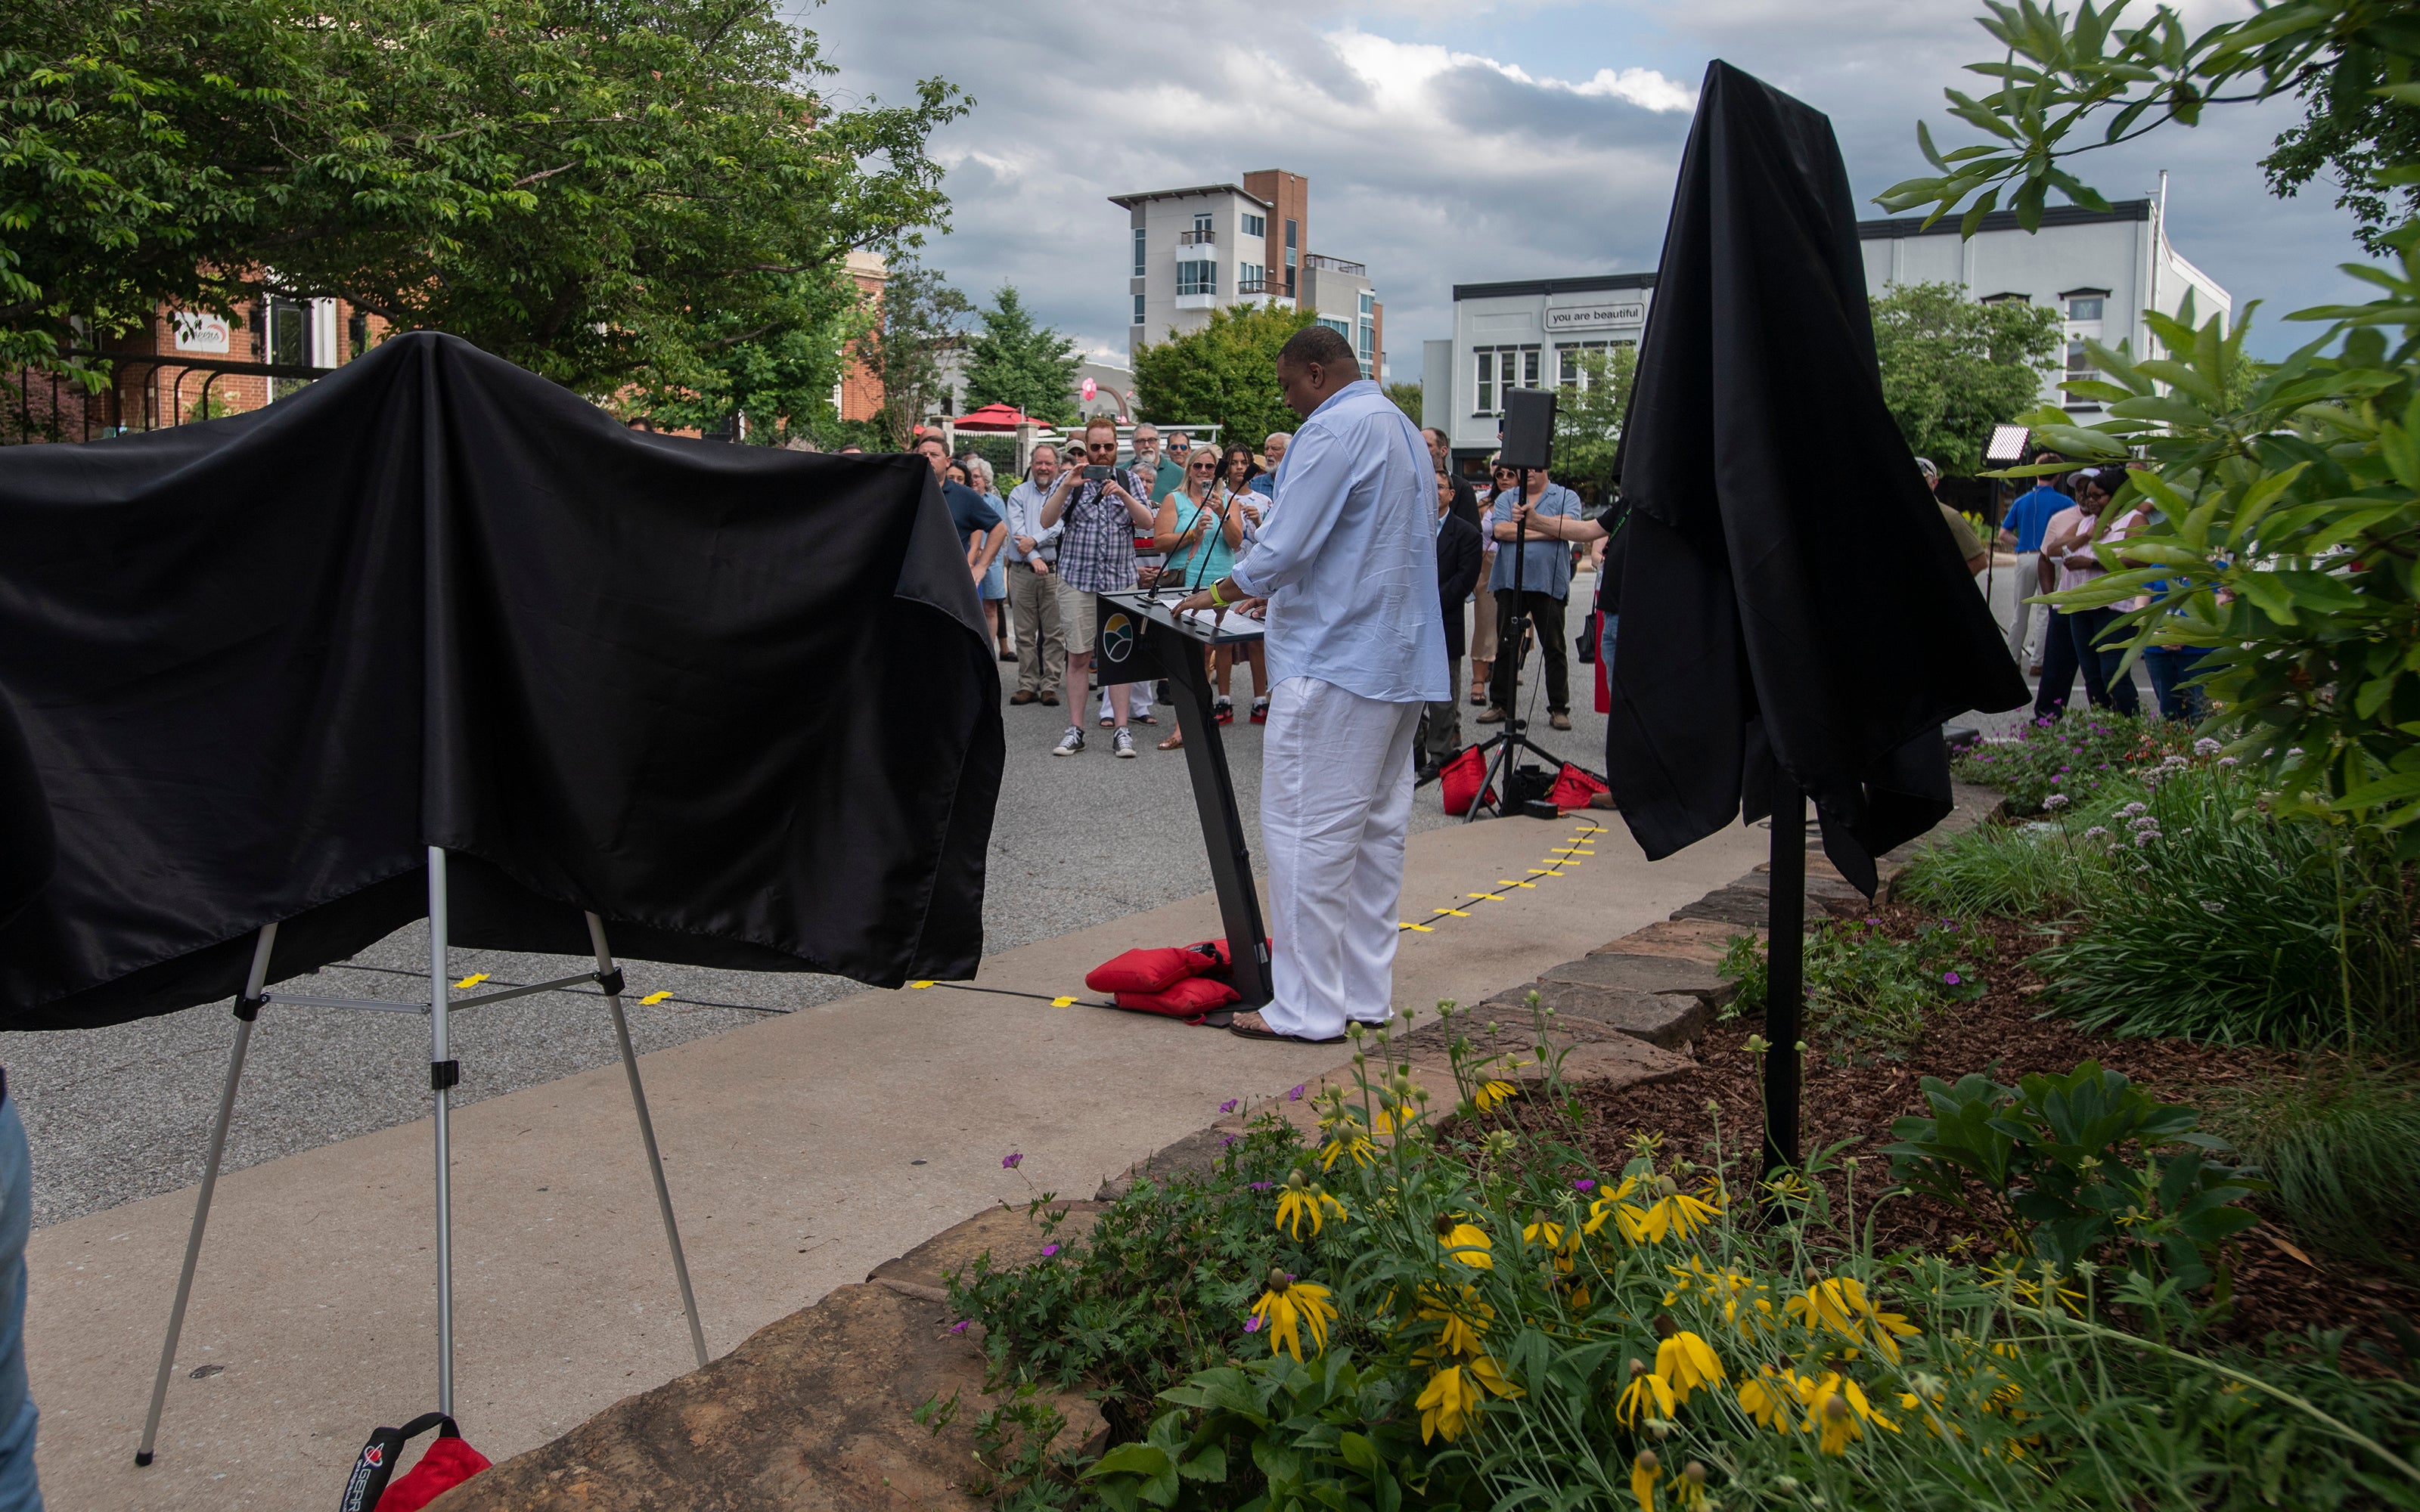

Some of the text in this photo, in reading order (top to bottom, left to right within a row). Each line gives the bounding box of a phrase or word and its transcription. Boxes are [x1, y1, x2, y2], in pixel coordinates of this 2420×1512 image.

[1553, 308, 1638, 324] you are beautiful
[348, 1468, 371, 1512] GEAR
